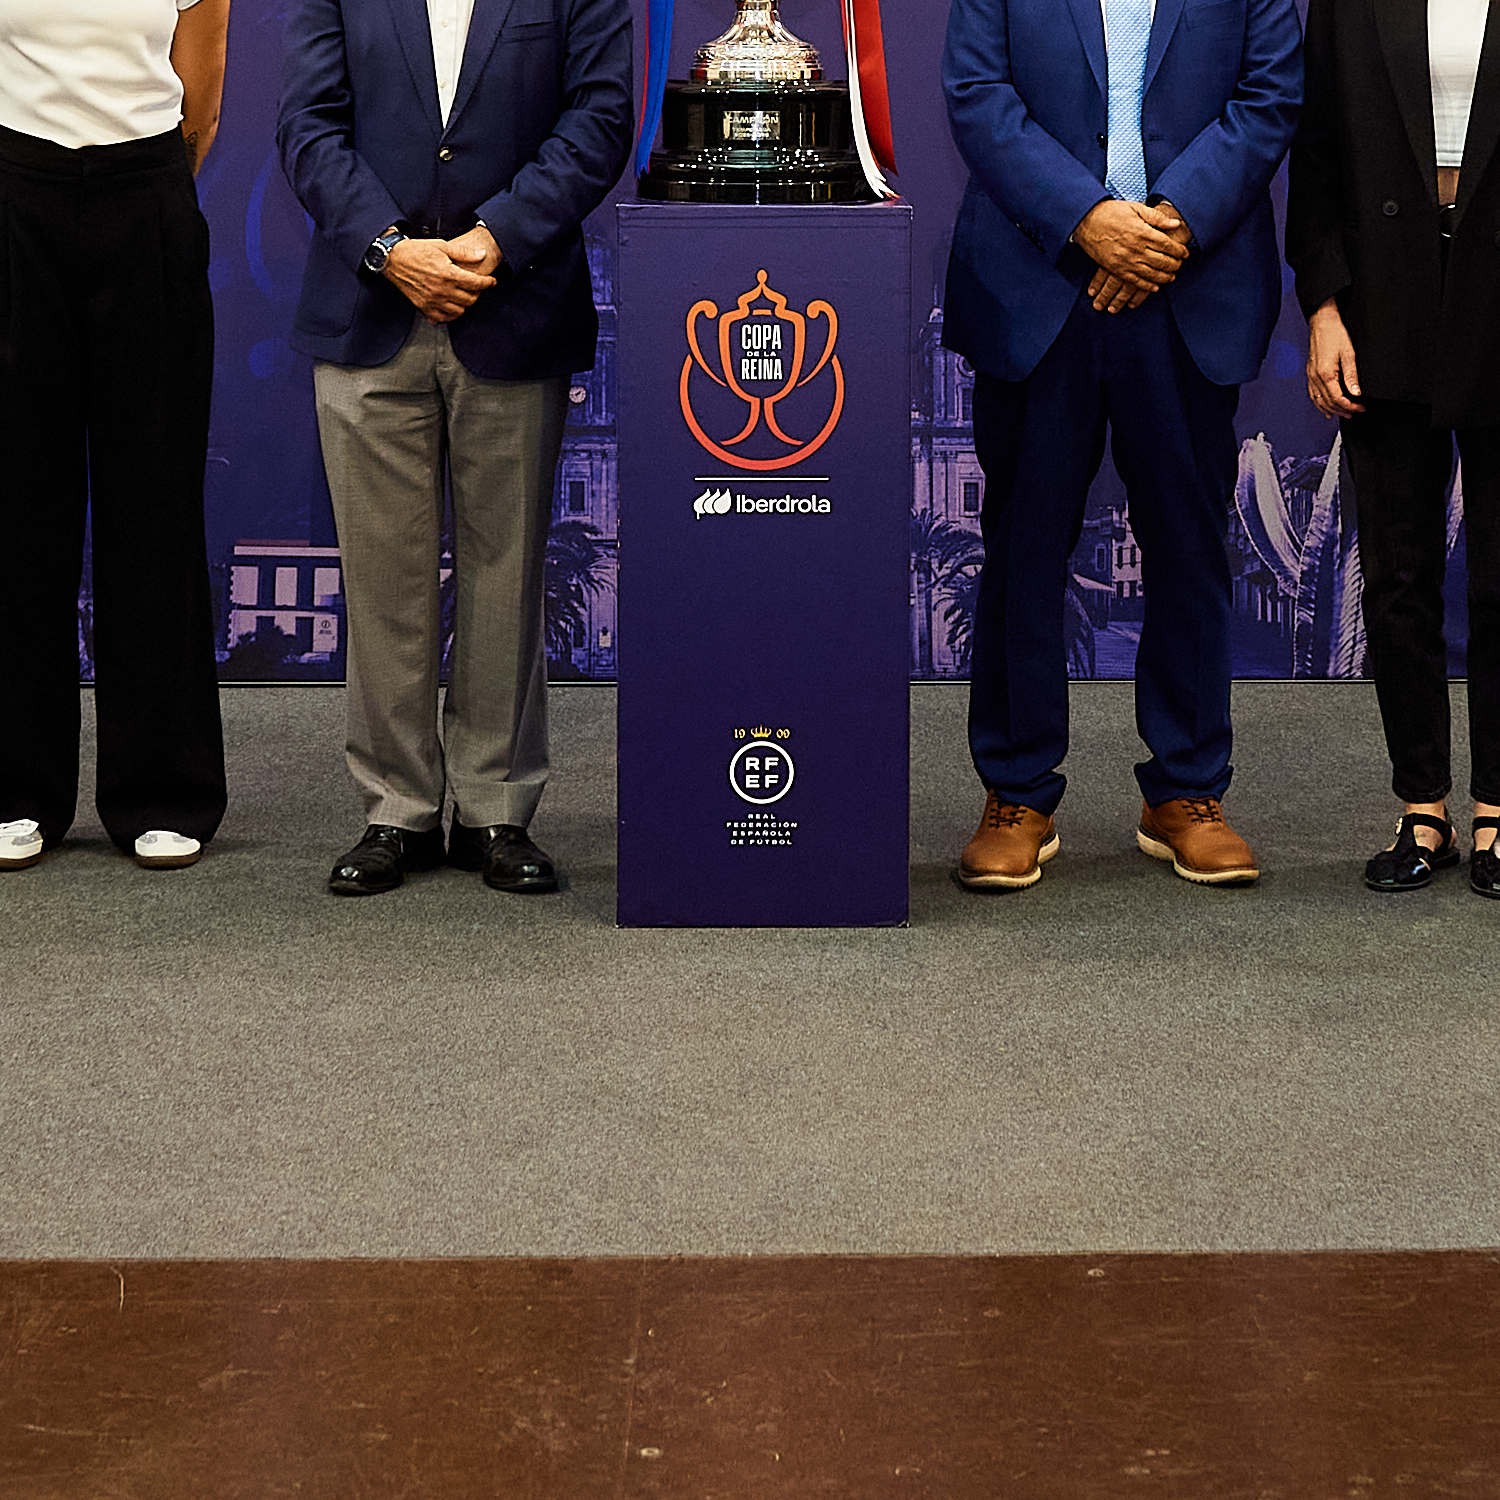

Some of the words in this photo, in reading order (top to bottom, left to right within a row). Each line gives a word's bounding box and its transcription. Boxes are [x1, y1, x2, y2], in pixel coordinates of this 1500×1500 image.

[741, 324, 782, 350] COPA
[741, 359, 783, 380] REINA
[736, 494, 831, 514] Iberdrola
